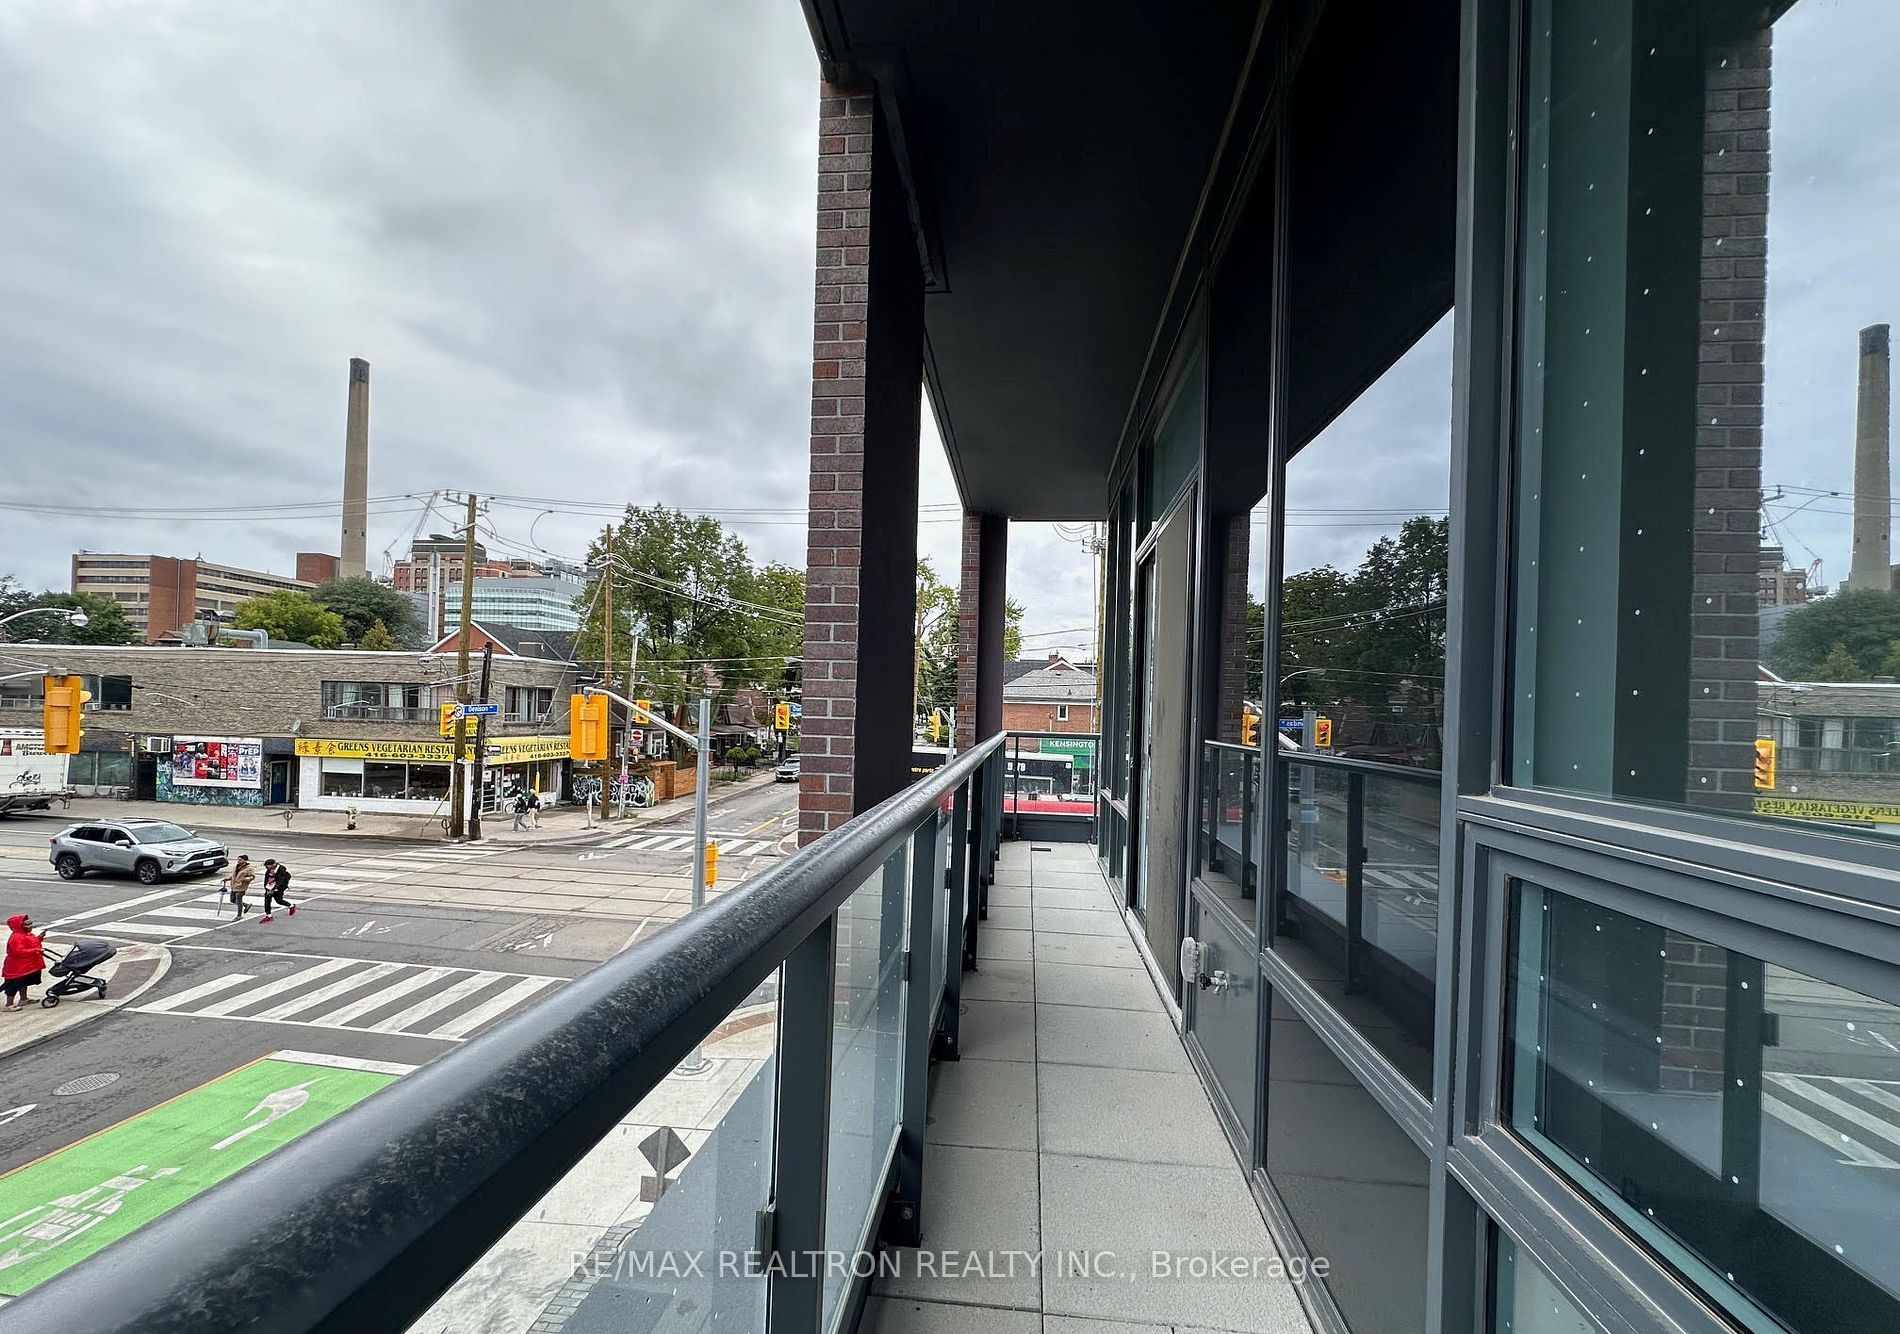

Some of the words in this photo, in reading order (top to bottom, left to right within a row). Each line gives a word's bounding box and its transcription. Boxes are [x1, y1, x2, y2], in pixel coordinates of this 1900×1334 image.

[468, 705, 489, 713] Denison
[337, 742, 369, 752] GREENS
[371, 743, 423, 754] VEGETARIAN
[500, 744, 517, 755] EENS
[518, 742, 553, 753] VEGETARIAN
[1049, 740, 1095, 749] KENSINGTO
[239, 747, 259, 755] PrEP
